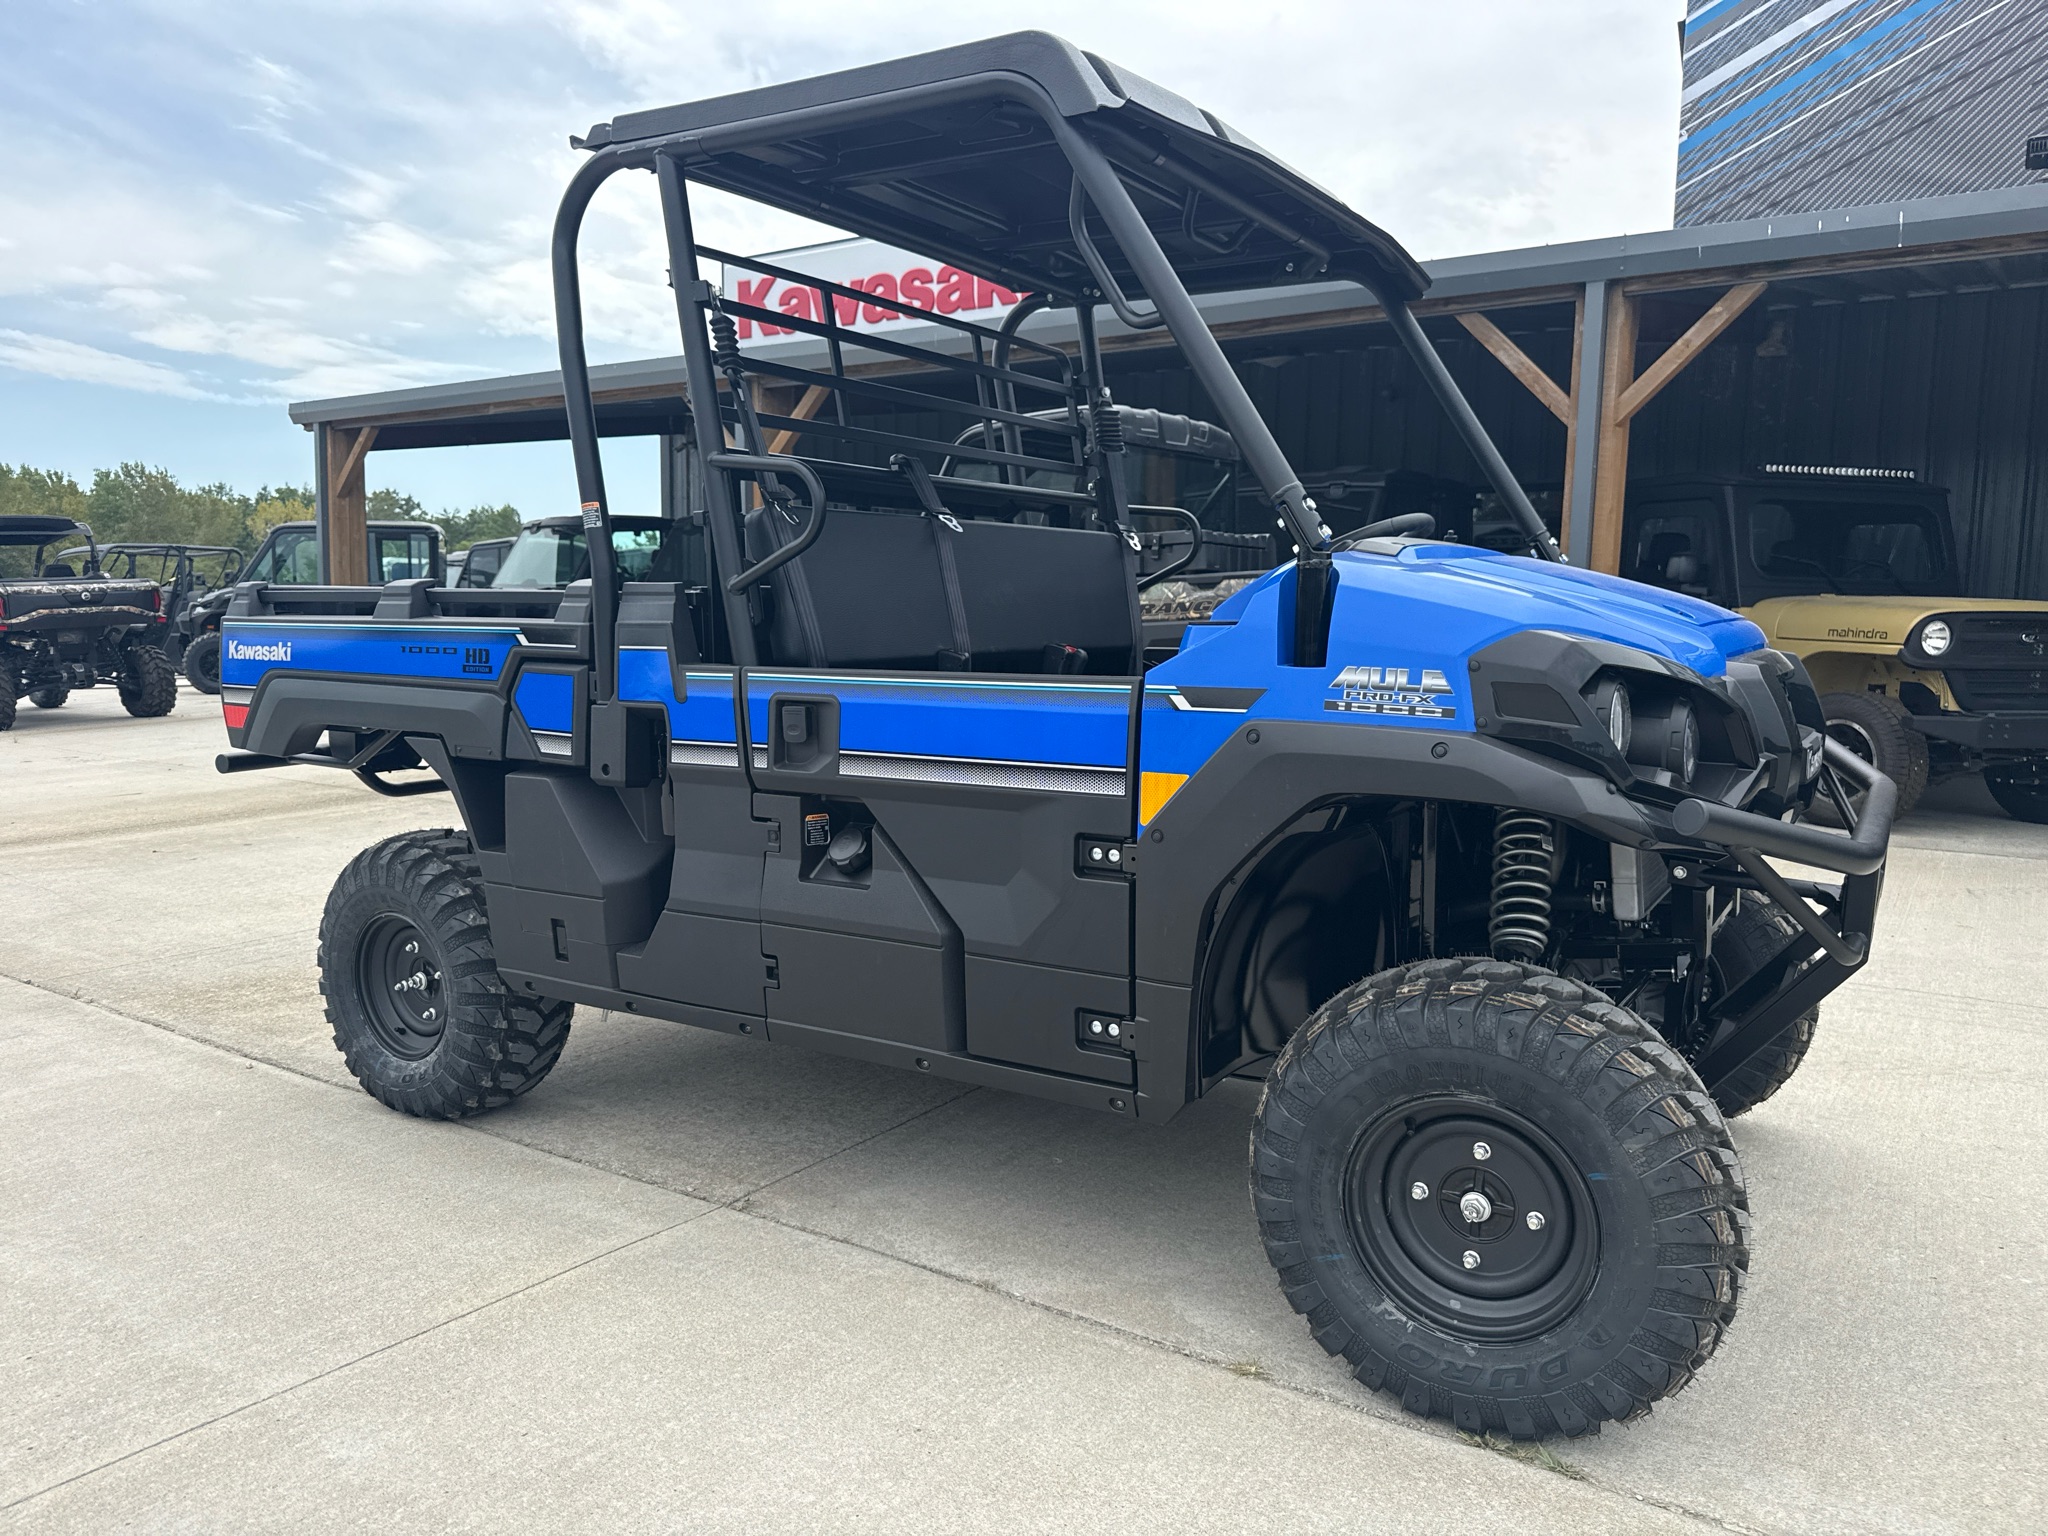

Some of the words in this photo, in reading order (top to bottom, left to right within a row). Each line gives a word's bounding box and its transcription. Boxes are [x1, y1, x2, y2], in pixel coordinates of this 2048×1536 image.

[737, 263, 1034, 340] Kawasak
[1827, 627, 1889, 640] mahindra
[228, 640, 292, 661] Kawasaki
[401, 645, 457, 654] 1000
[465, 647, 490, 665] HD
[464, 665, 491, 673] EDITION
[1328, 665, 1455, 695] MULE
[1343, 689, 1436, 705] PRO-FX
[1336, 702, 1443, 717] 1000
[1396, 1341, 1570, 1391] DURO
